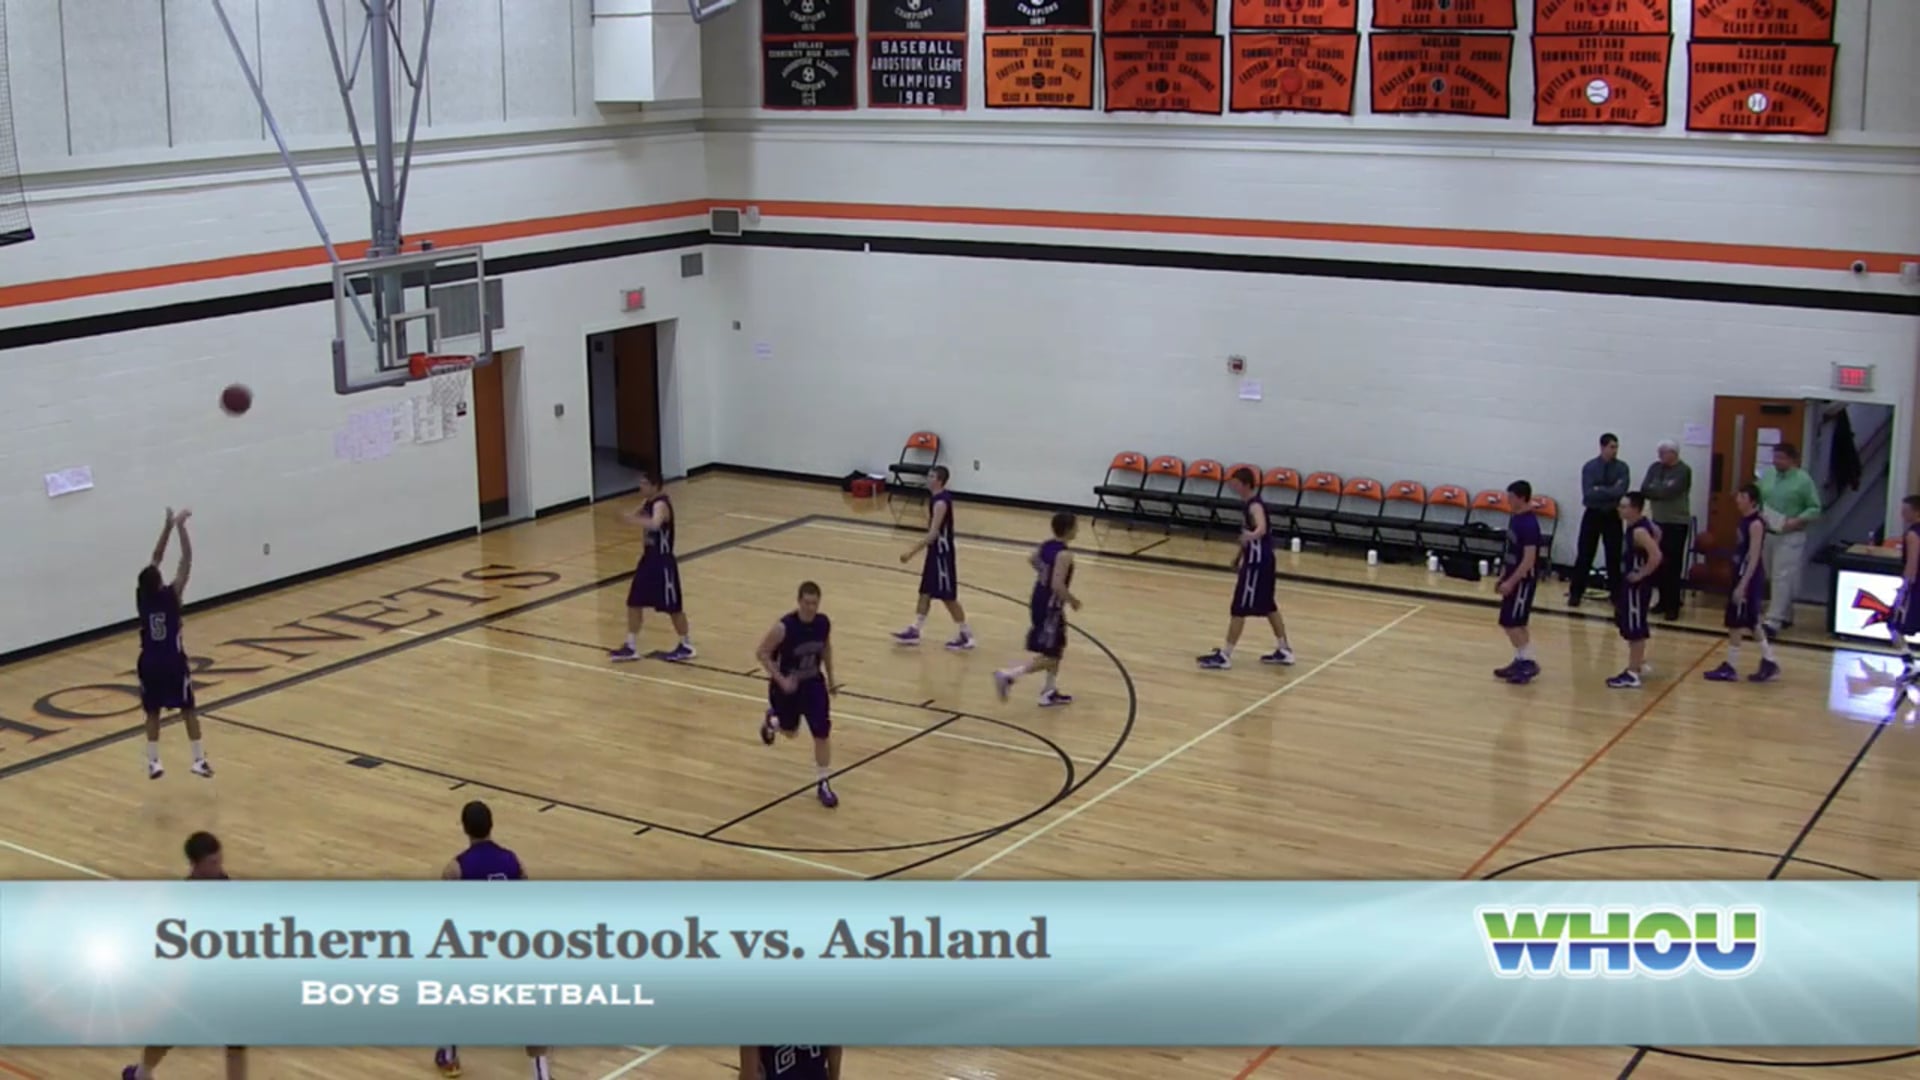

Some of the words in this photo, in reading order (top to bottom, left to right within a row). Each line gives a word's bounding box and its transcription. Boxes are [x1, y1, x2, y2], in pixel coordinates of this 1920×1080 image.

[1017, 2, 1059, 16] CHAMPIONS
[1565, 21, 1593, 31] CLASS
[1608, 20, 1639, 31] GIRLS
[1723, 23, 1755, 33] CLASS
[1768, 24, 1798, 34] GIRLS
[881, 41, 954, 54] BASEBALL
[1579, 38, 1625, 49] ASHLAND
[1541, 51, 1596, 63] COMMUNITY
[1630, 51, 1662, 63] SCHOOL
[1738, 48, 1787, 60] ASHLAND
[871, 57, 923, 71] AROOSTOOK
[928, 58, 963, 72] LEAGUE
[1695, 62, 1755, 74] COMMUNITY
[1759, 63, 1783, 75] HIGH
[1789, 63, 1827, 76] SCHOOL
[882, 75, 951, 89] CHAMPIONS
[1542, 69, 1576, 105] EASTERN
[1580, 64, 1610, 76] MAINE
[899, 91, 935, 105] 1982
[1694, 84, 1735, 114] EASTERN
[1738, 78, 1770, 91] MAINE
[1773, 81, 1825, 118] CHAMPIONS
[1610, 108, 1638, 120] GIRLS
[1720, 114, 1752, 125] CLASS
[1765, 116, 1796, 127] GIRLS
[149, 612, 167, 641] 5
